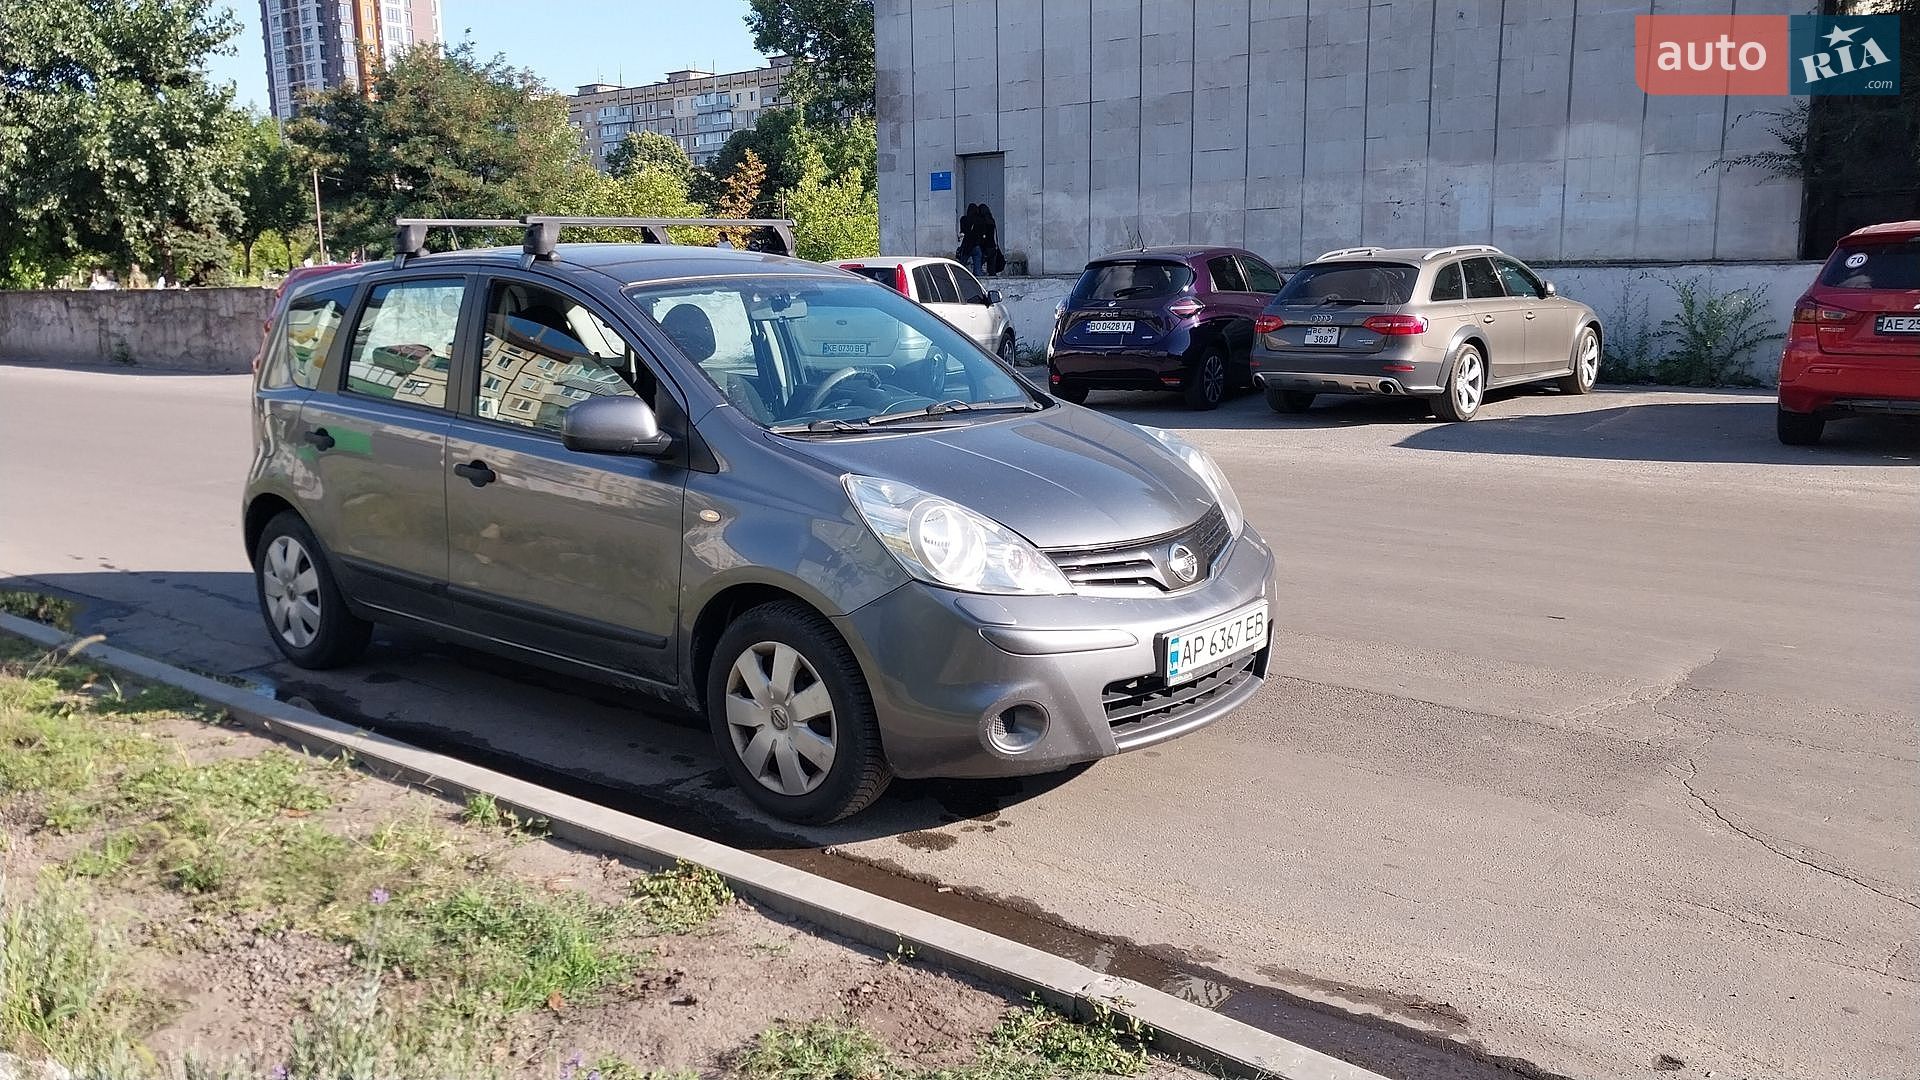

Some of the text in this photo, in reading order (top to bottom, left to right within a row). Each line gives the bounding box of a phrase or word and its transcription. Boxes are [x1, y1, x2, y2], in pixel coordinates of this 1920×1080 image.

[1851, 257, 1864, 265] 70
[1091, 322, 1101, 331] BO
[1102, 322, 1120, 331] 0428
[1885, 319, 1904, 330] AE
[1314, 335, 1333, 344] 3887
[1181, 612, 1264, 667] AP 6367 EB
